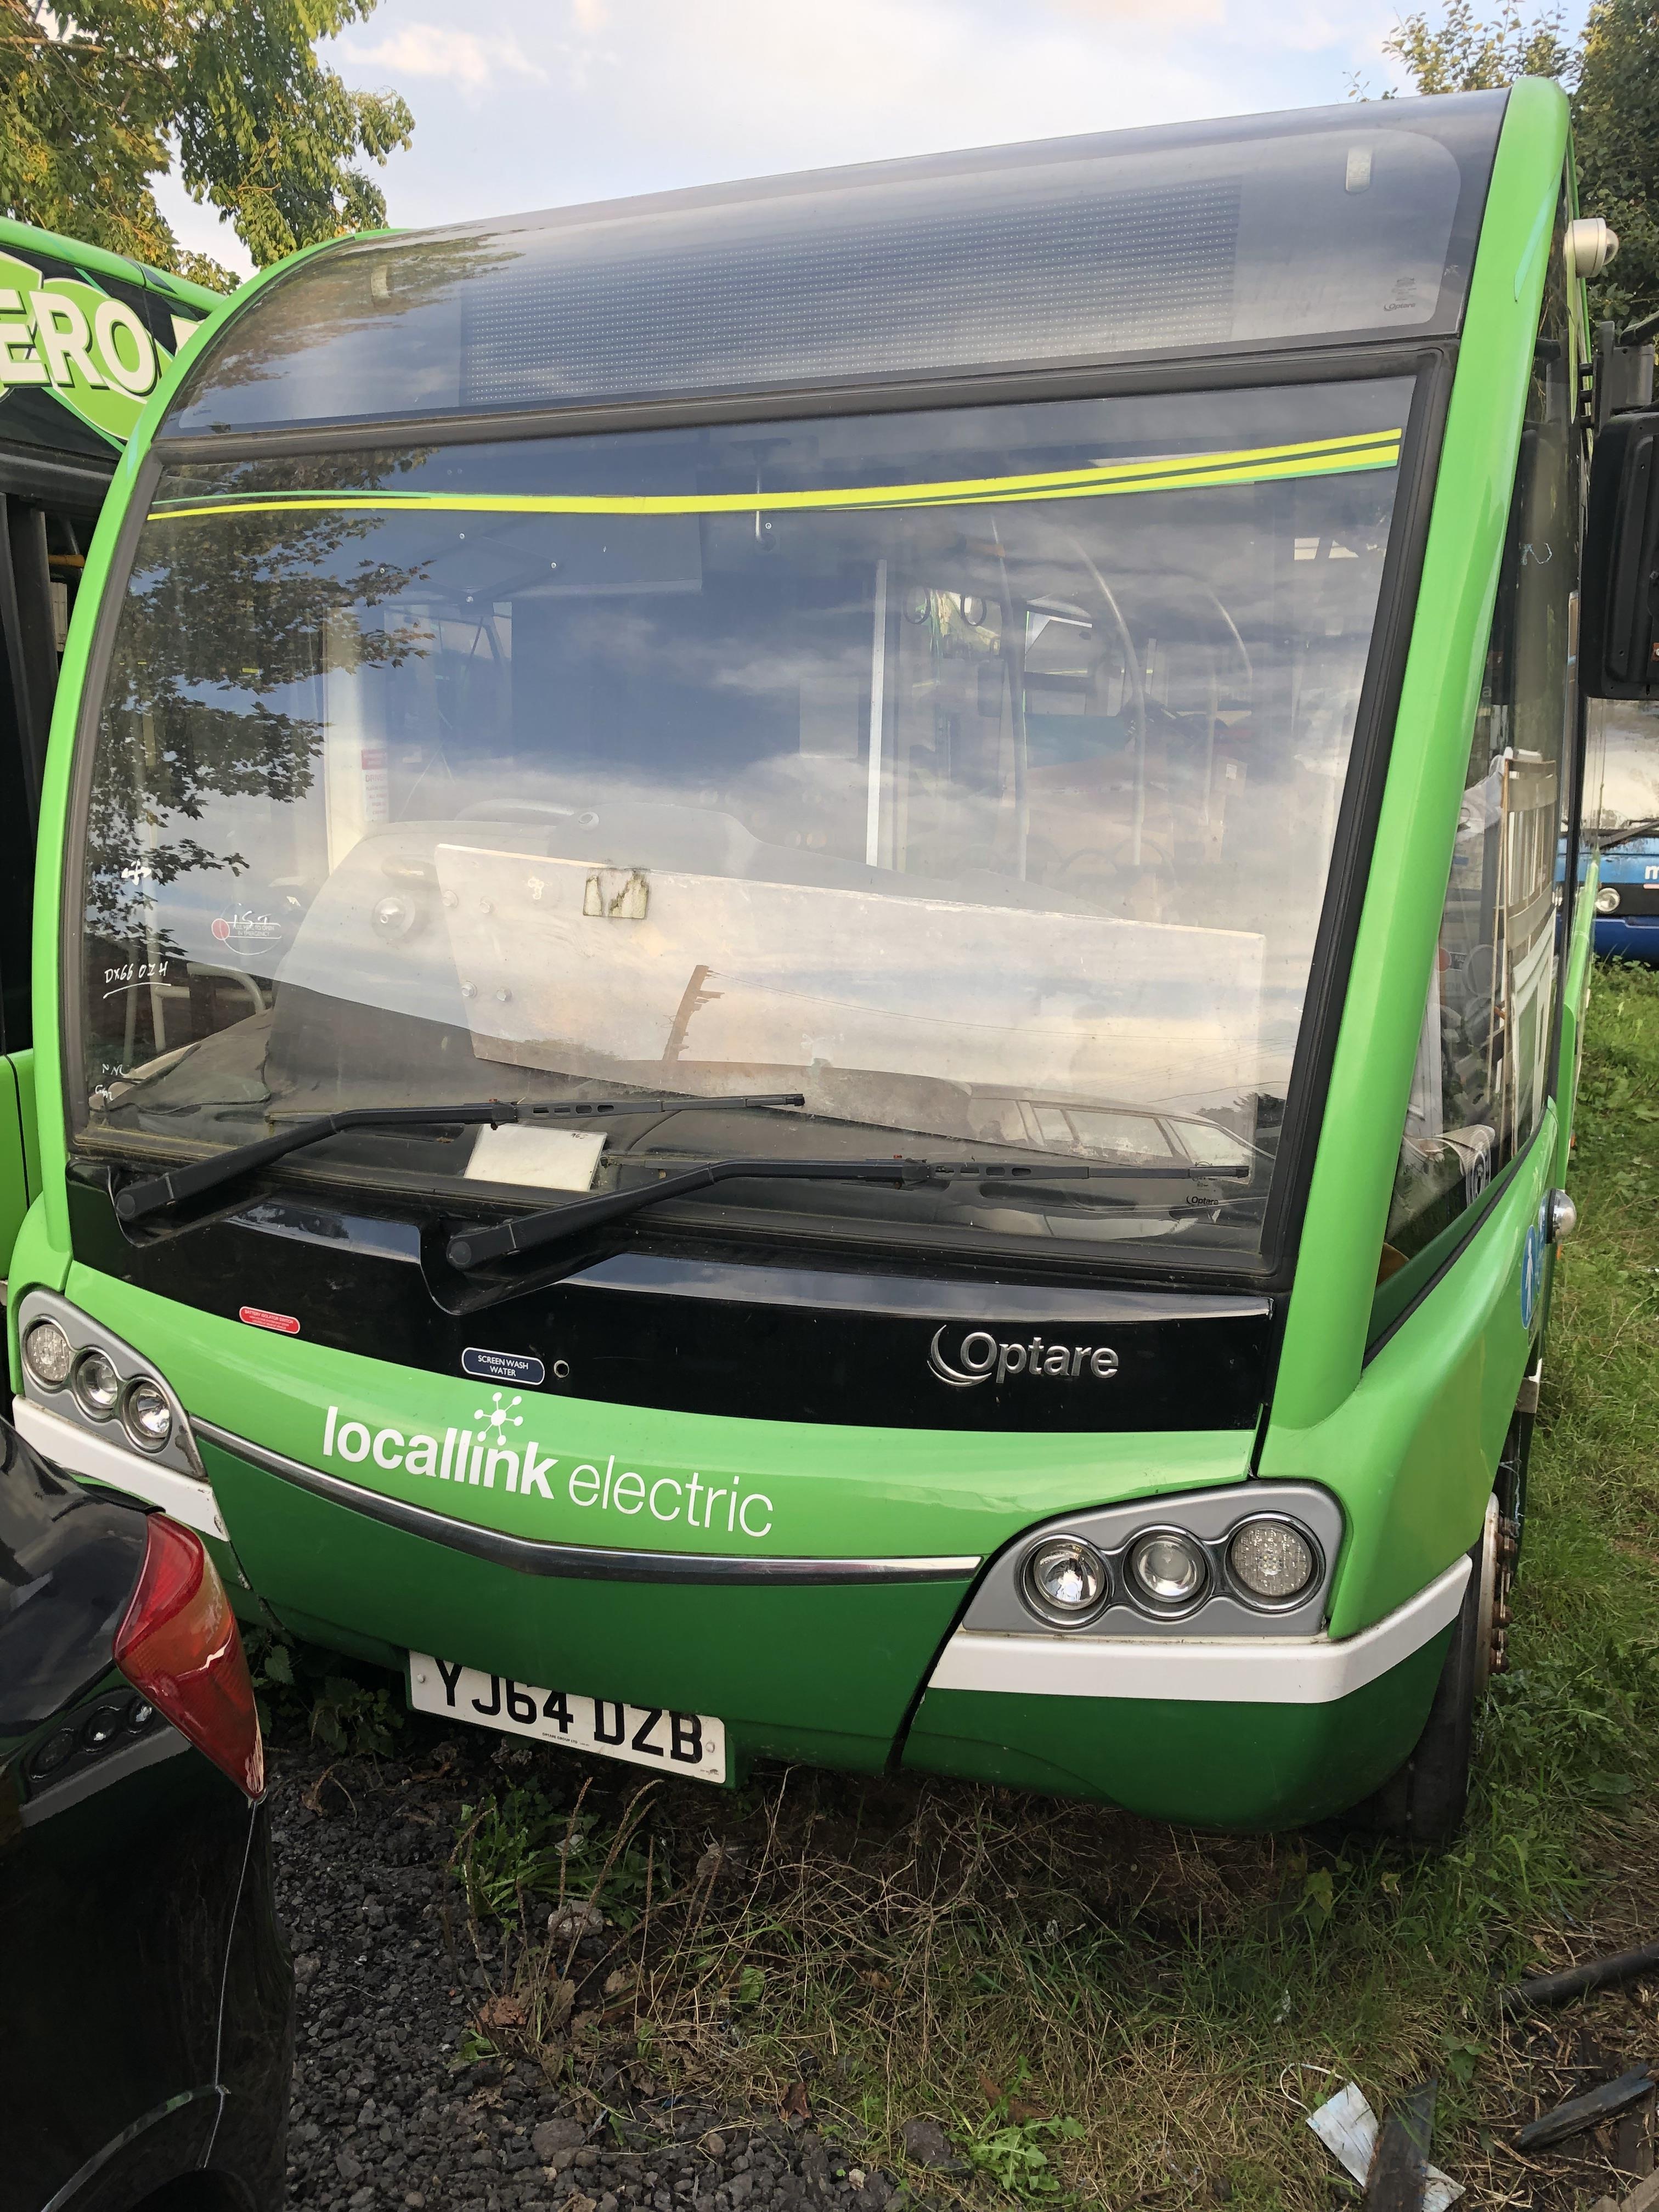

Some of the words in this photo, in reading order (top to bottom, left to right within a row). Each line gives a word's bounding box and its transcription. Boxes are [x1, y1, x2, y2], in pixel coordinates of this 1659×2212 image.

[104, 963, 134, 983] DX66
[478, 1355, 505, 1366] SCREEN
[506, 1359, 528, 1370] WASH
[489, 1365, 516, 1377] WATER
[960, 1331, 1119, 1384] Optare
[322, 1406, 558, 1500] locallink
[568, 1454, 774, 1537] electric
[435, 1658, 574, 1734] YJ64
[594, 1697, 703, 1764] DZB
